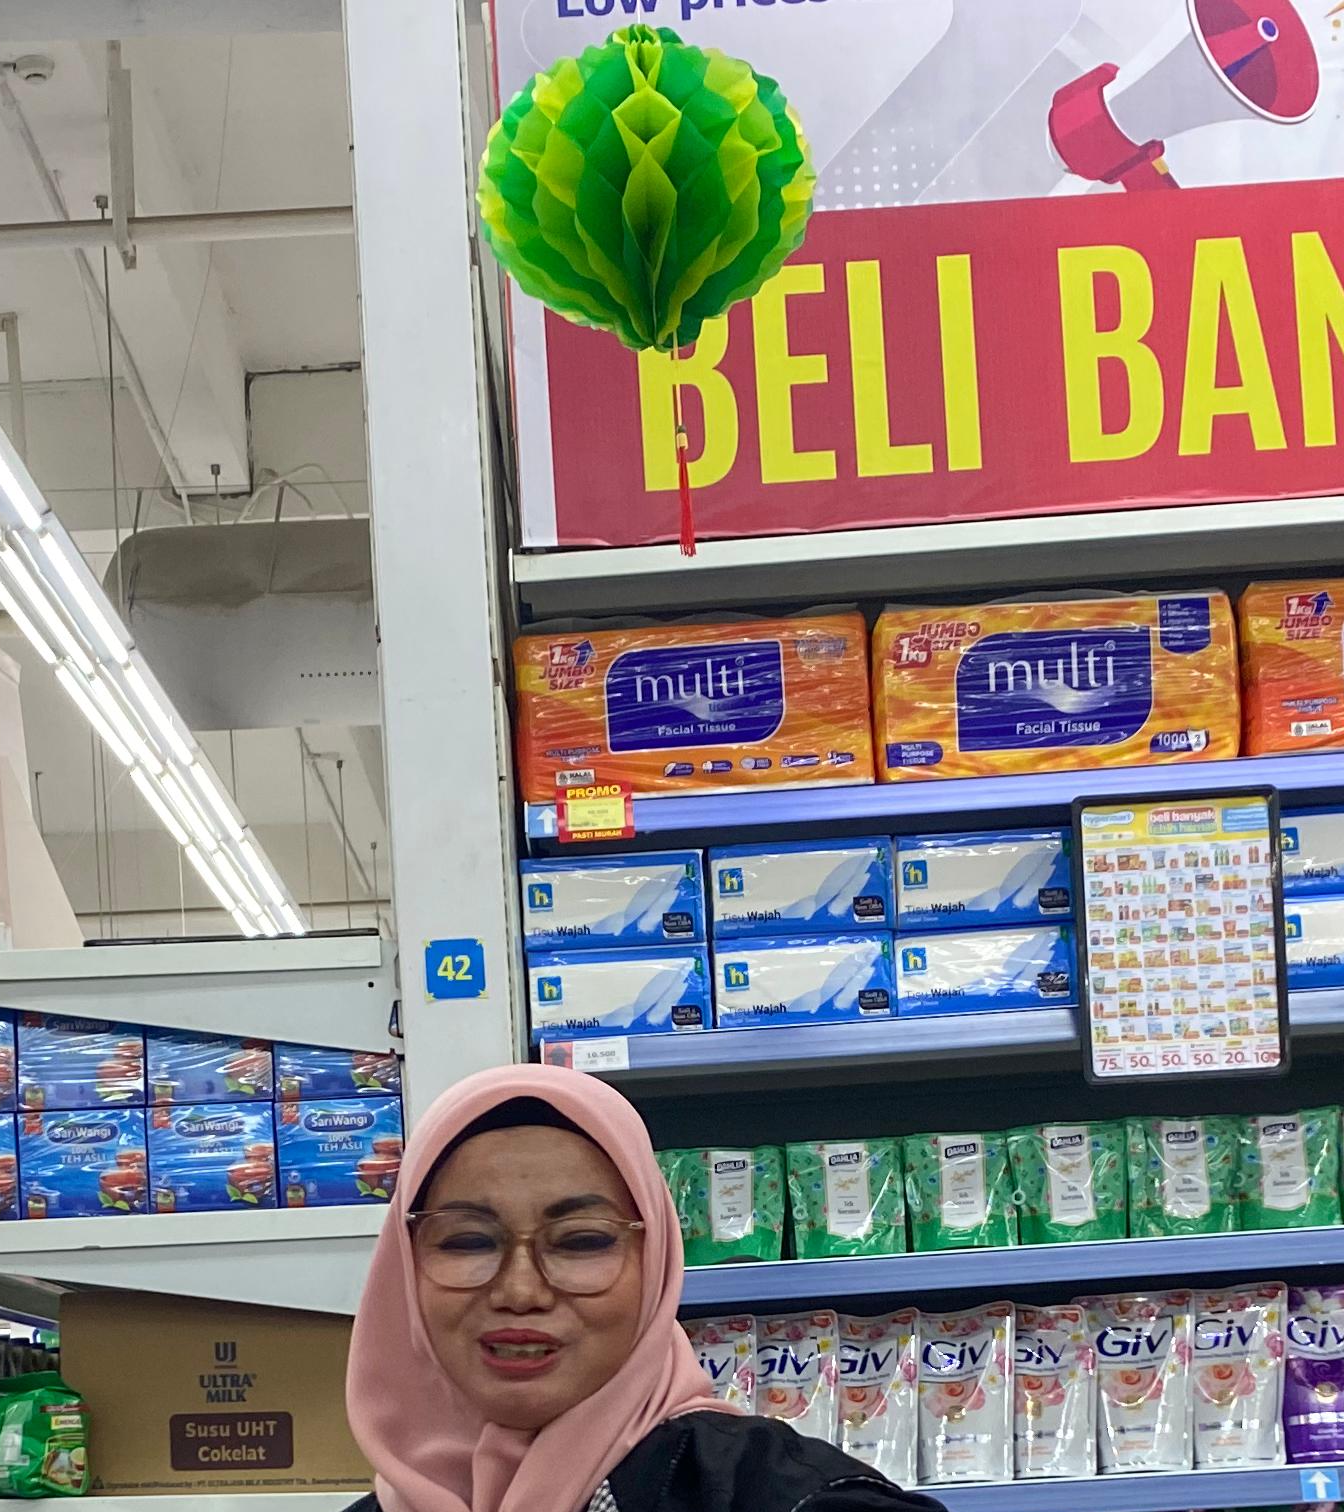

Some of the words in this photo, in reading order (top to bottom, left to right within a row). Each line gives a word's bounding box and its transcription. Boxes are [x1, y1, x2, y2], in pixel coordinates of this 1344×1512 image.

[636, 253, 983, 493] BELI
[1275, 613, 1333, 631] JUMBO
[918, 622, 981, 640] JUMBO
[1286, 627, 1323, 641] SIZE
[539, 665, 596, 680] JUMBO
[988, 640, 1116, 692] multi
[549, 678, 585, 690] SIZE
[636, 657, 745, 703] multi
[657, 725, 694, 737] Facial
[698, 722, 737, 734] Tissue
[1016, 721, 1056, 735] Facial
[1059, 719, 1101, 733] Tissue
[566, 785, 622, 799] PROMO
[1149, 811, 1170, 823] beli
[1172, 808, 1217, 824] banyak
[931, 901, 966, 914] Wajah
[746, 909, 781, 924] Wajah
[556, 924, 591, 938] Wajah
[436, 954, 473, 981] 42
[752, 1003, 787, 1017] Wajah
[565, 1017, 600, 1031] Wajah
[310, 1110, 368, 1129] SariWangi
[54, 1121, 112, 1140] SariWangi
[318, 1143, 338, 1153] TEH
[342, 1141, 363, 1152] ASLI
[946, 1144, 977, 1158] DAHLIA
[61, 1153, 82, 1164] TEH
[84, 1153, 106, 1163] ASLI
[829, 1152, 860, 1165] DAHLIA
[199, 1374, 254, 1389] ULTRA
[206, 1389, 247, 1403] MILK
[185, 1422, 231, 1438] Susu
[238, 1421, 278, 1437] UHT
[198, 1445, 266, 1462] Cokelat
